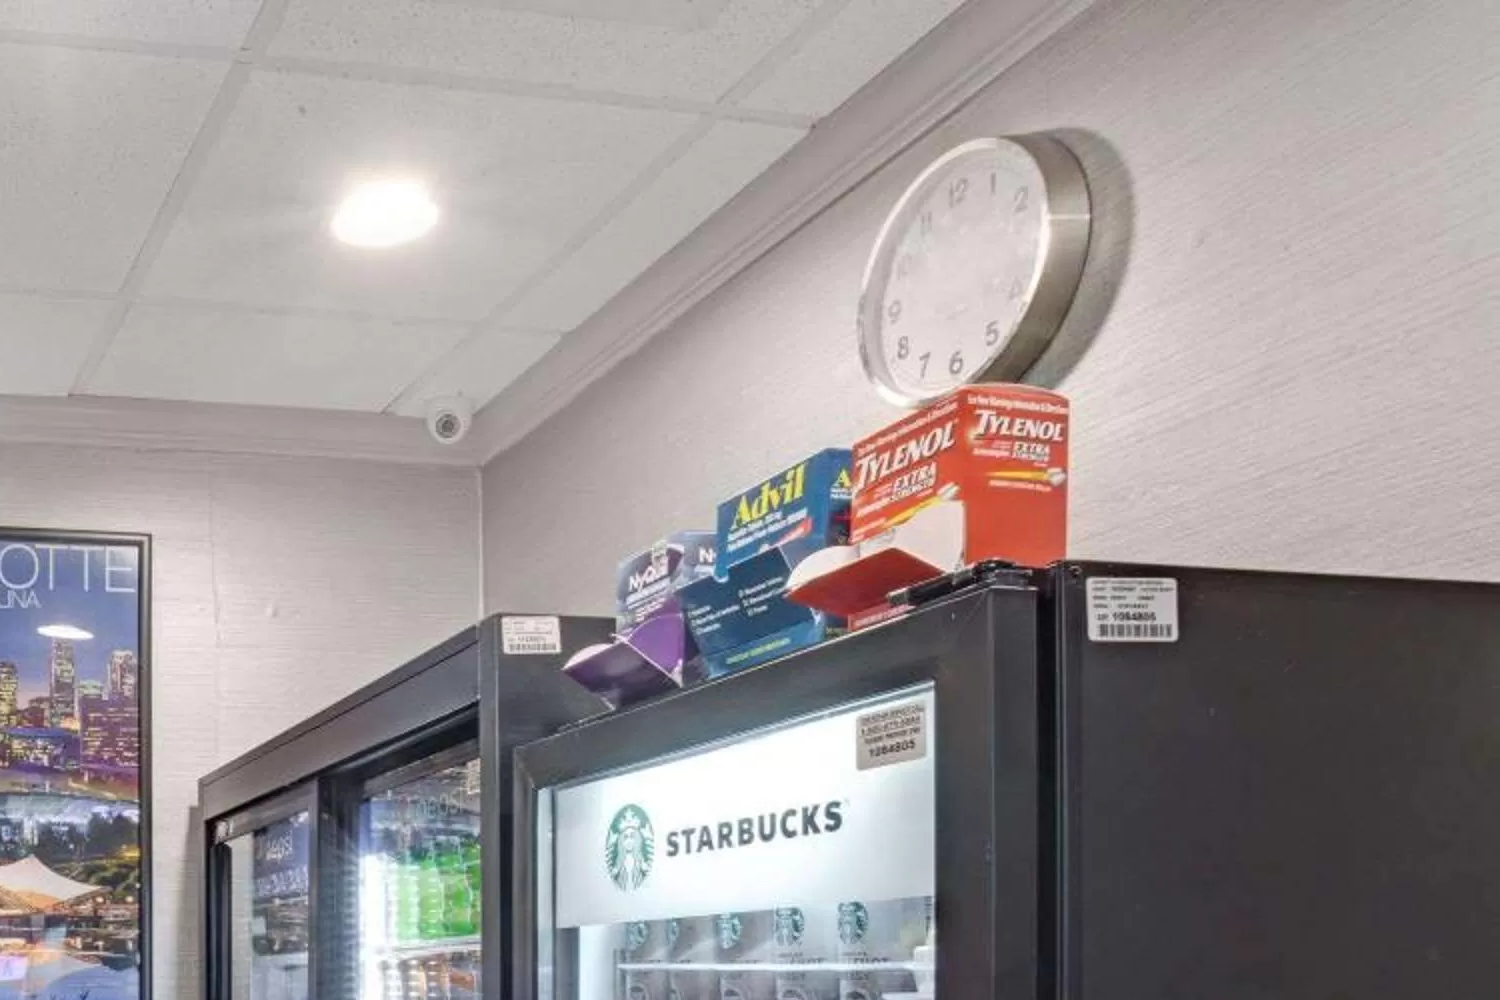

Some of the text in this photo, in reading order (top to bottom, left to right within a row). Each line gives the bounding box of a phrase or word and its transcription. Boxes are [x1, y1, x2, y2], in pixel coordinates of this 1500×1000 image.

[897, 335, 910, 361] 8
[985, 320, 1000, 347] 5
[919, 352, 931, 379] 7
[949, 351, 964, 375] 6
[974, 409, 1064, 441] TYLENOL
[855, 421, 956, 496] TYLENOL
[730, 463, 805, 529] Advil
[666, 799, 844, 858] STARBUCKS
